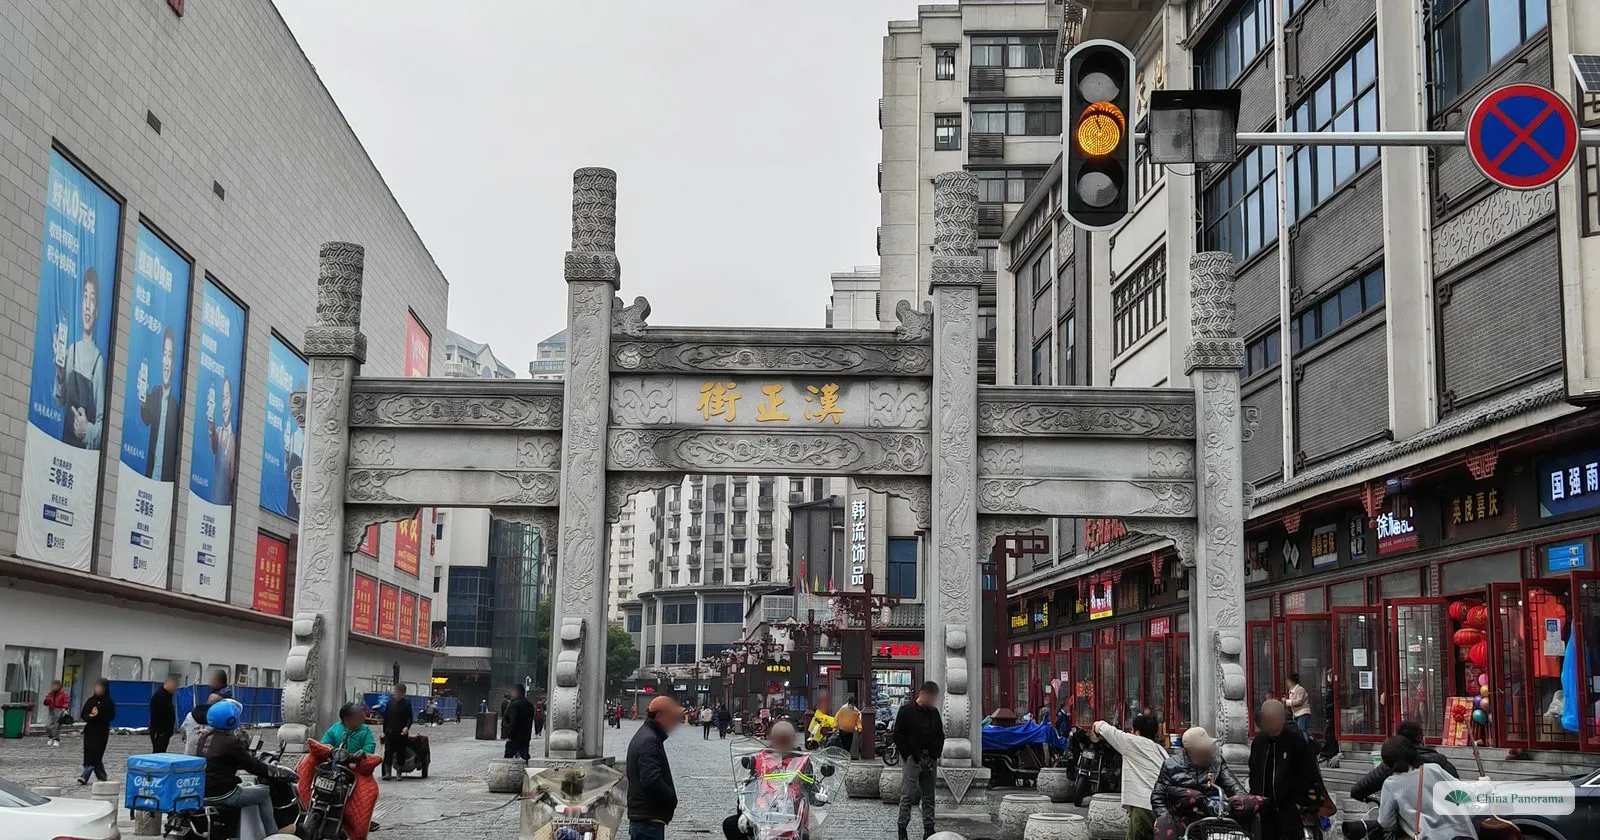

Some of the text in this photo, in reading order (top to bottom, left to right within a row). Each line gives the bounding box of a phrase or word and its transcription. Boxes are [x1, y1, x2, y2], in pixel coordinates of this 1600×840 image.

[48, 467, 74, 490] 三零服务
[851, 499, 866, 586] 韩流饰品
